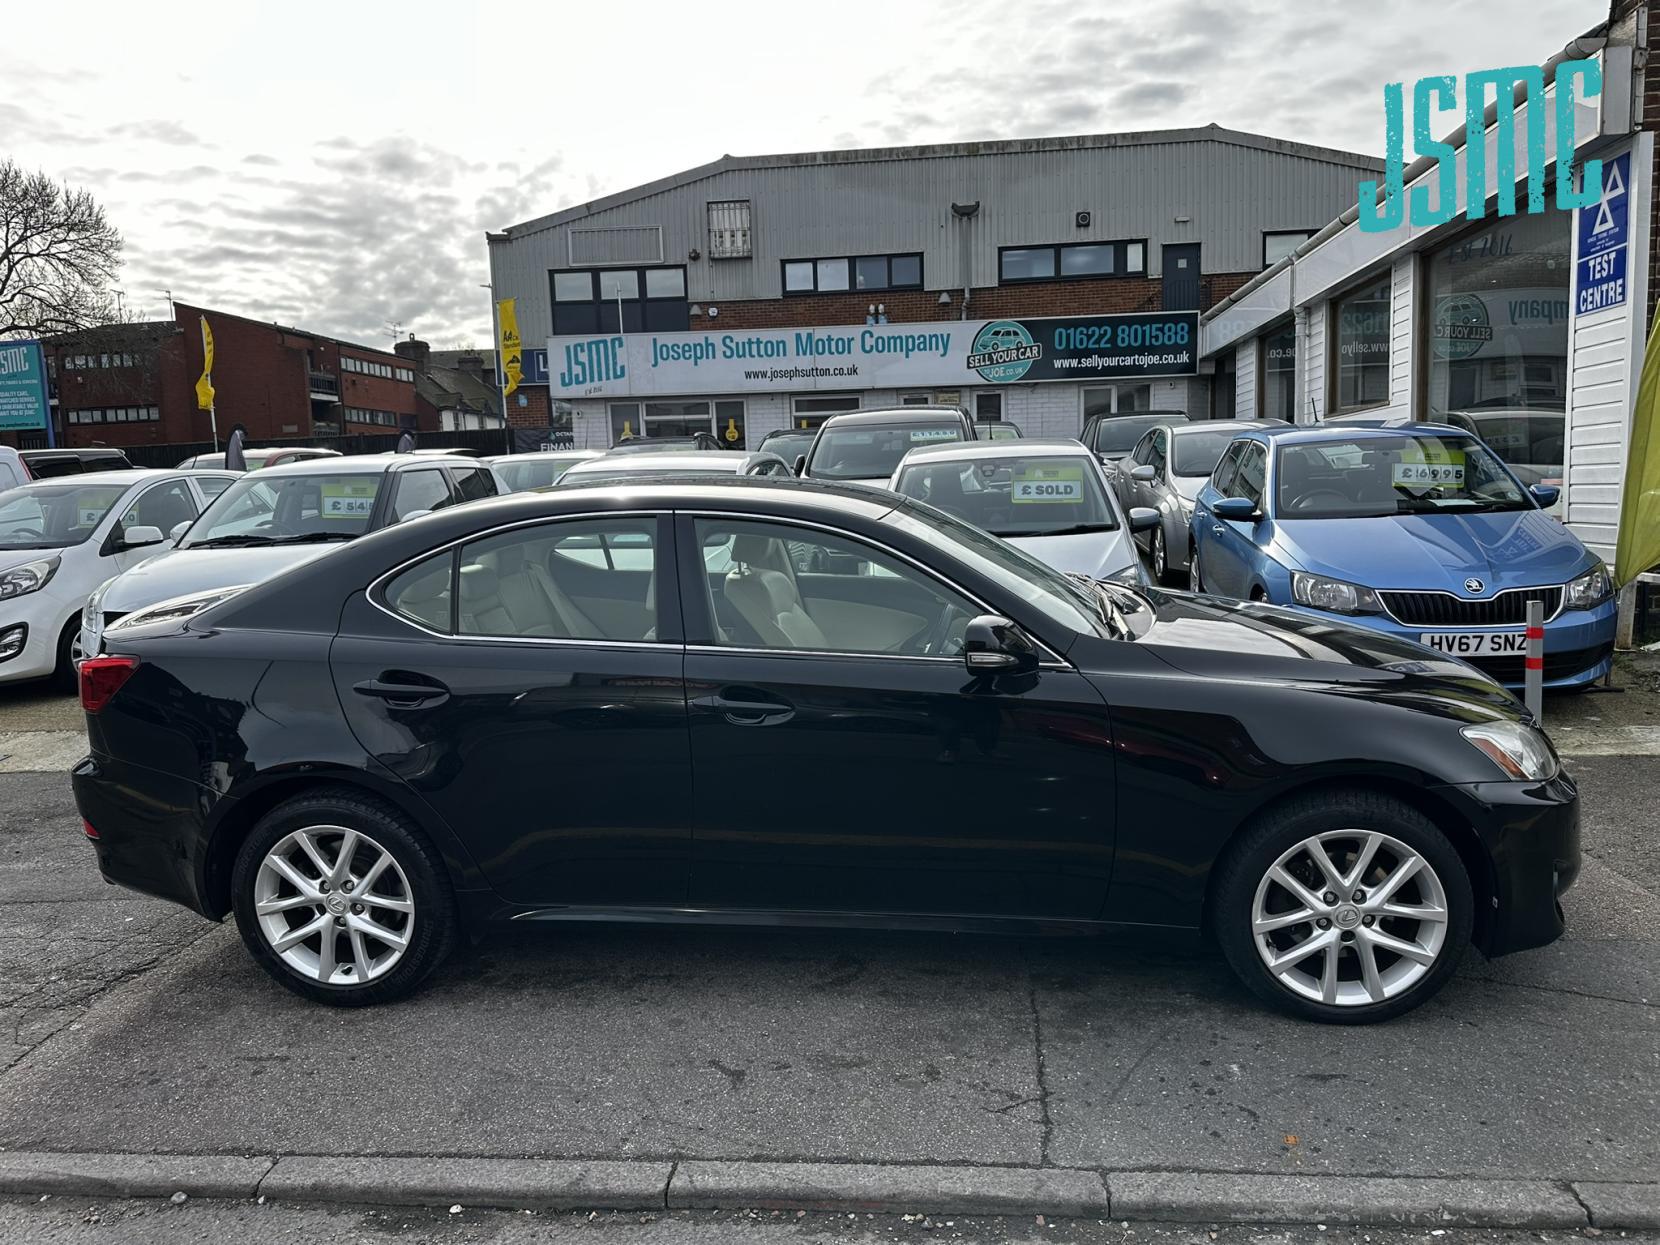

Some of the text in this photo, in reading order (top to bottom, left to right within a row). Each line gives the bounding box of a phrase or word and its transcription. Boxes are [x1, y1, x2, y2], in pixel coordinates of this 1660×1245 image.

[1588, 251, 1616, 281] TEST
[1580, 278, 1623, 312] CENTRE
[651, 329, 951, 367] Joseph Sutton Motor Company
[1054, 322, 1189, 350] 01622 801588
[0, 346, 30, 375] SMC
[560, 336, 626, 388] JSMC
[969, 346, 1039, 367] SELL YOUR CAR
[1053, 350, 1190, 370] www.sellyourcartojoe.co.uk
[744, 363, 859, 382] www.josephsutton.co.uk
[1035, 484, 1074, 496] SOLD
[1430, 634, 1526, 653] HV67 SNZ
